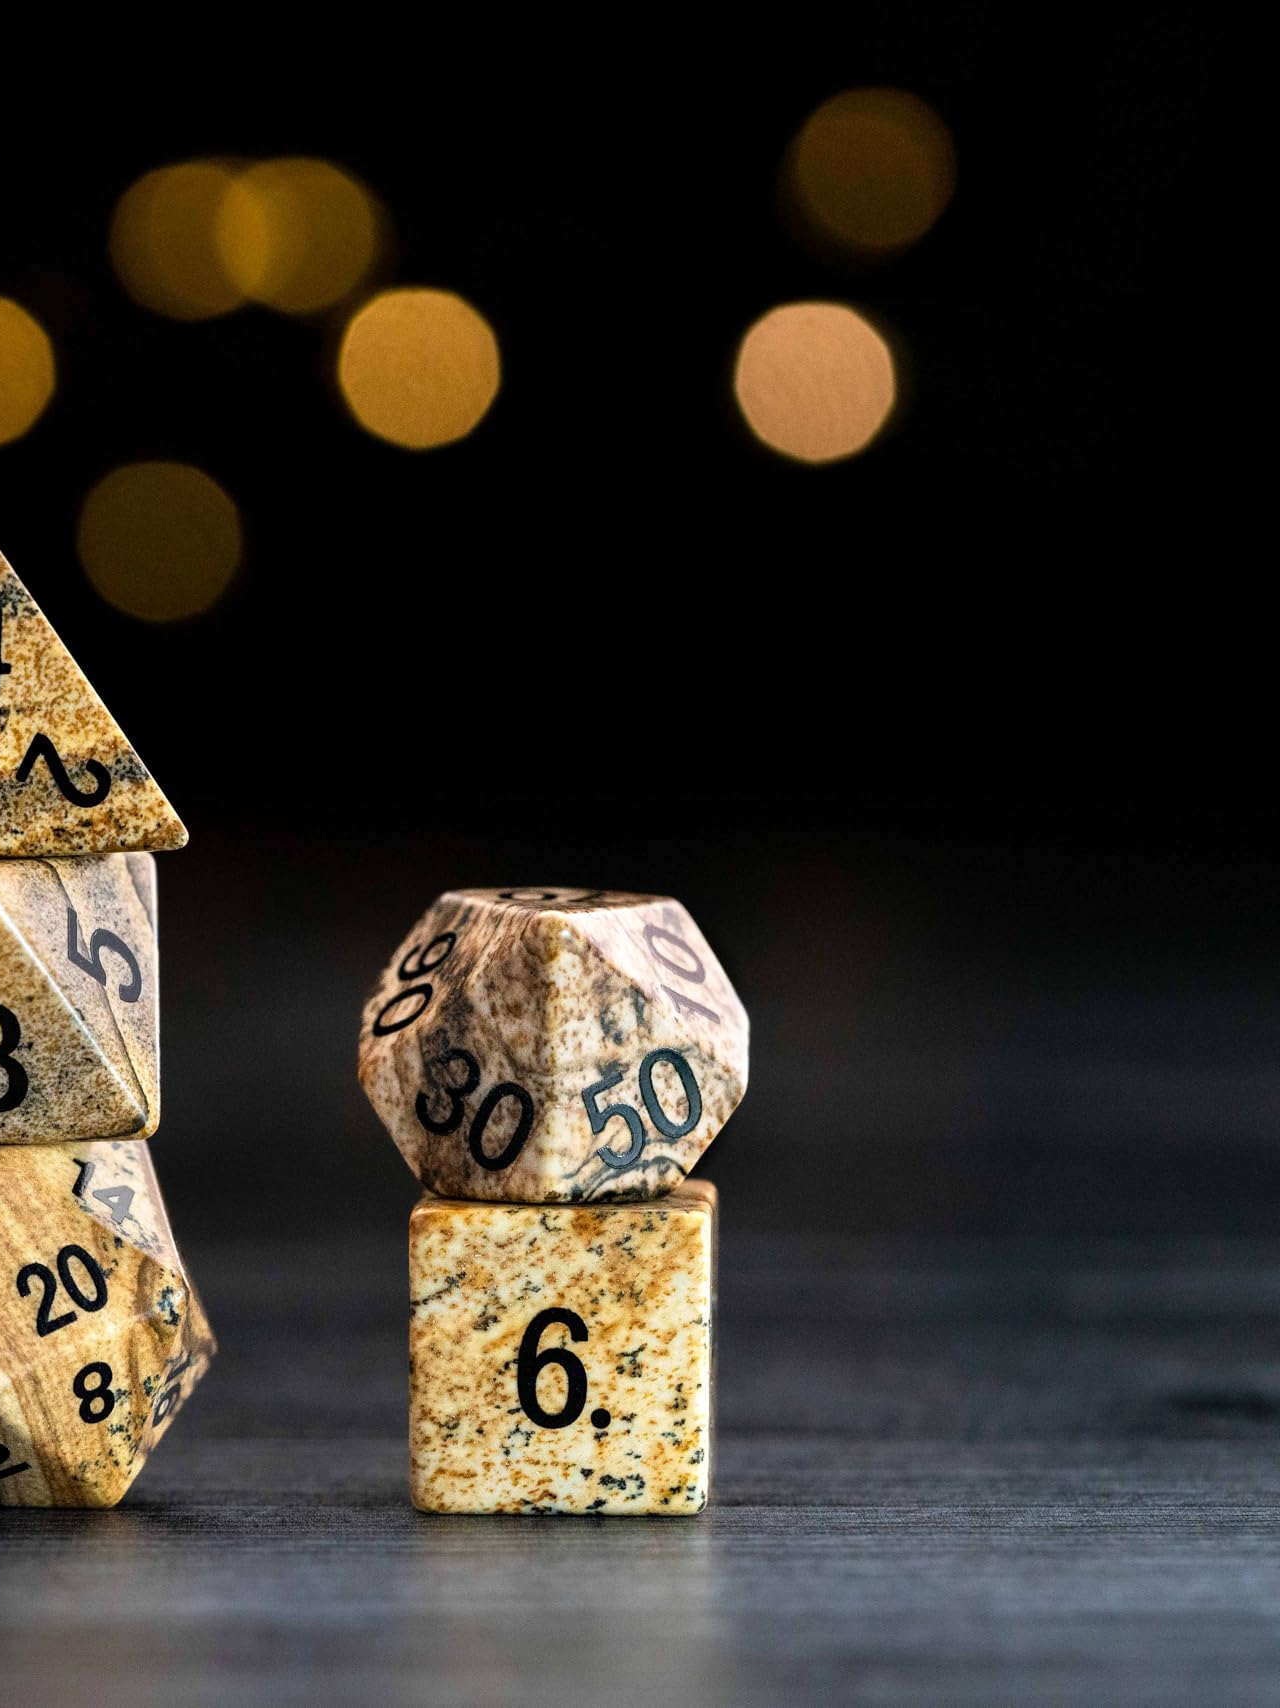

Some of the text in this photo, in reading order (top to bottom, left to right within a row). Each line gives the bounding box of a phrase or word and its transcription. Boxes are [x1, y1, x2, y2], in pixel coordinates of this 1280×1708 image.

[15, 732, 112, 808] 2
[67, 907, 142, 1004] 5
[643, 923, 721, 1025] 10
[415, 1048, 534, 1171] 30
[581, 1047, 703, 1170] 50
[72, 1158, 135, 1224] 14
[16, 1244, 109, 1338] 20
[72, 1361, 115, 1424] 8
[516, 1306, 612, 1430] 6.
